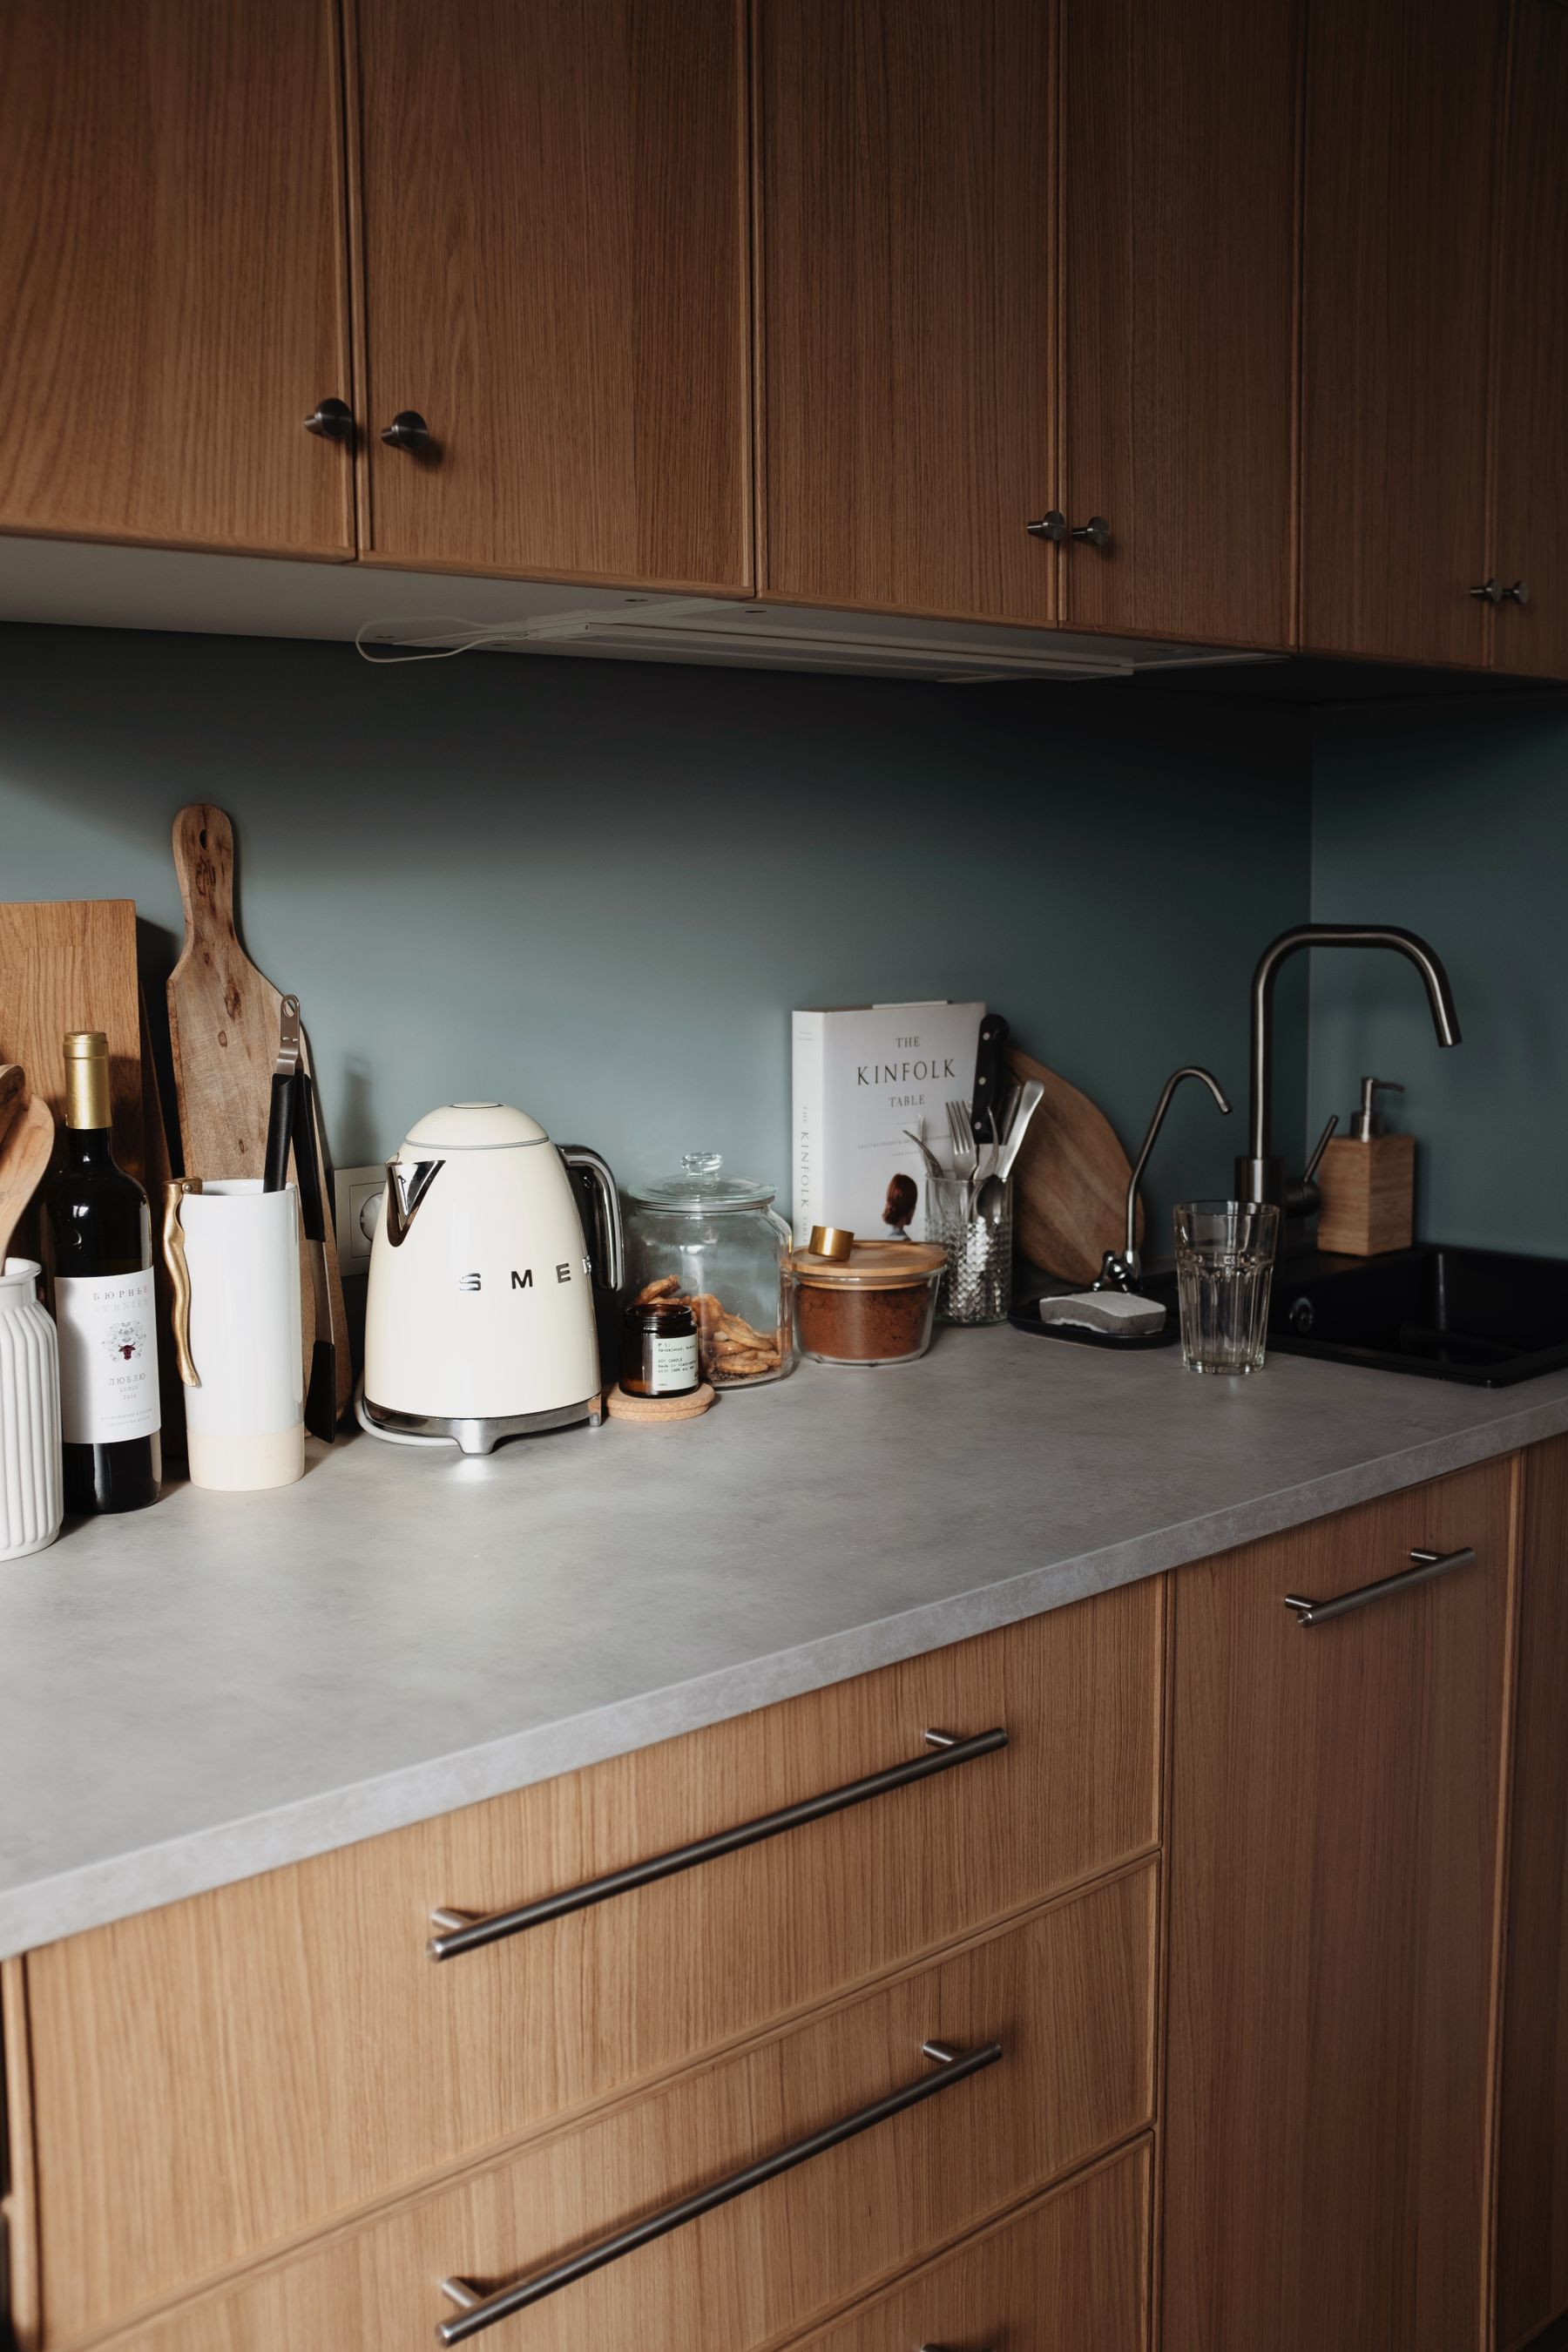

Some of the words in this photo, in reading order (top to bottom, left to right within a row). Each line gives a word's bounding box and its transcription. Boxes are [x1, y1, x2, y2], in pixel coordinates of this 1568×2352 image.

[895, 1036, 920, 1049] THE
[856, 1058, 956, 1085] KINFOLK
[888, 1094, 925, 1108] TABLE
[801, 1132, 809, 1207] KINFOLK
[108, 1372, 146, 1386] ЛЮБЛЮ
